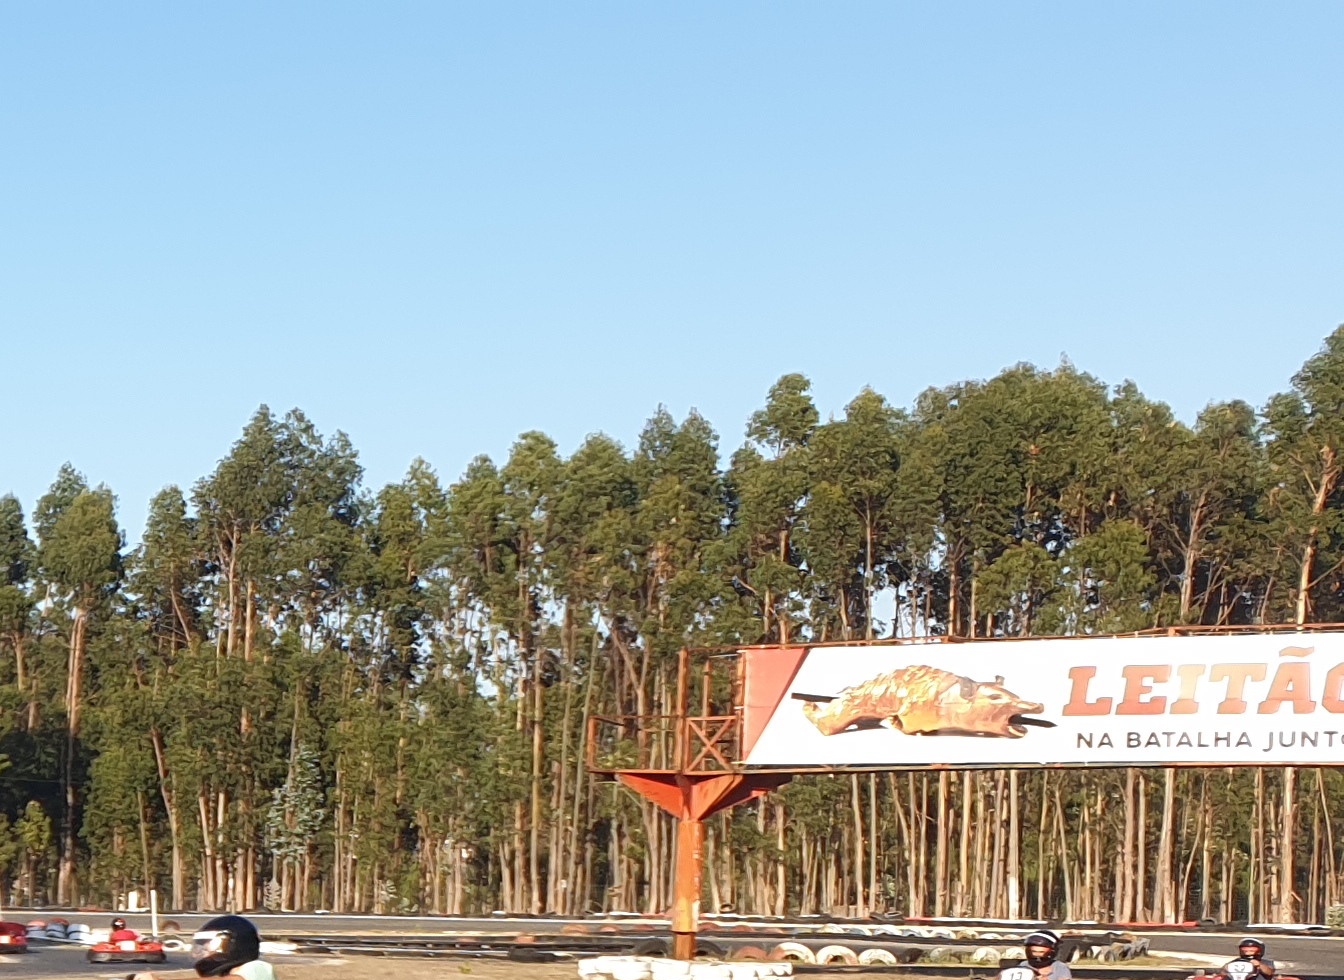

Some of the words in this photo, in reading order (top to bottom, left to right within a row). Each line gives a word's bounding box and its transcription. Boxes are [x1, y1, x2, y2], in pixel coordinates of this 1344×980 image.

[1076, 732, 1114, 748] NA
[1126, 731, 1252, 748] BATALHA
[1262, 730, 1344, 752] JUNT
